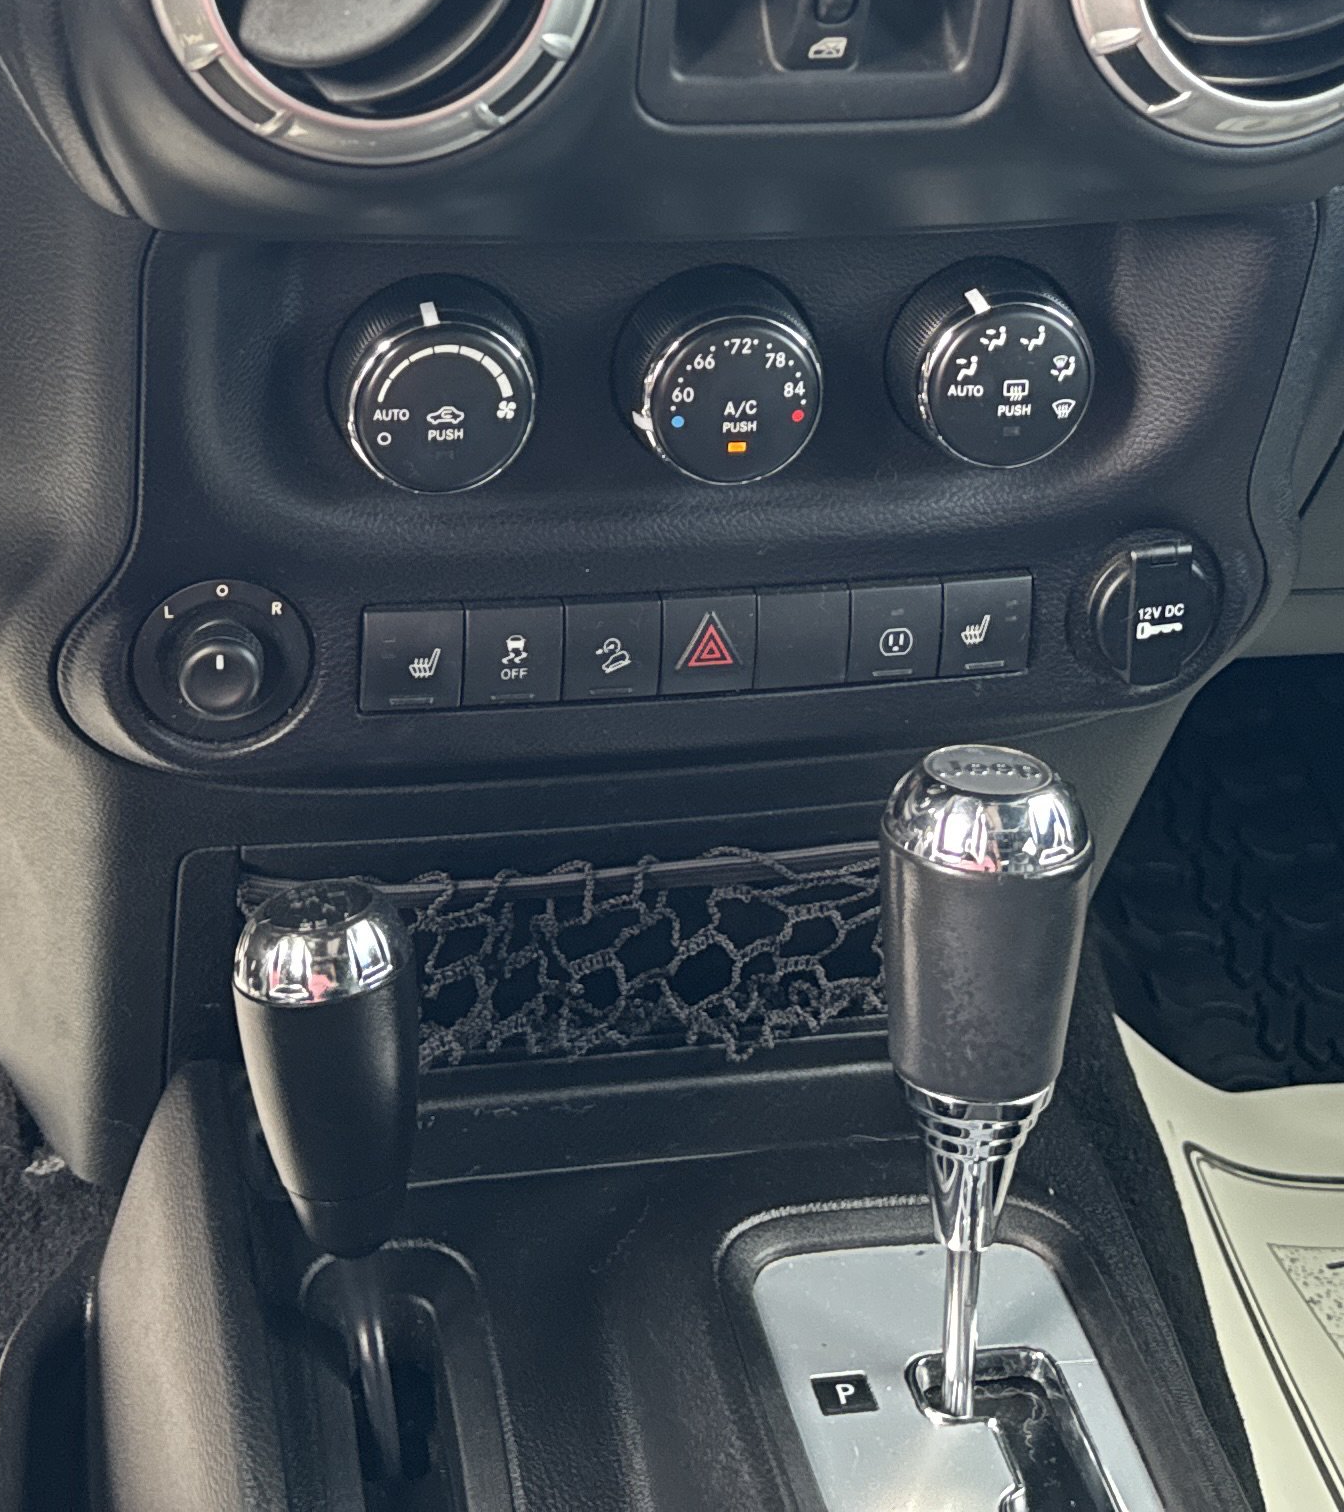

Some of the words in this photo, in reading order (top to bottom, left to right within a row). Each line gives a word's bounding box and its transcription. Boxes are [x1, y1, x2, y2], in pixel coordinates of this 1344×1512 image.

[731, 339, 752, 355] 72
[694, 353, 716, 370] 66
[765, 352, 786, 369] 78
[672, 385, 694, 403] 60
[783, 380, 806, 397] 84
[947, 384, 984, 398] AUTO
[373, 408, 410, 422] AUTO
[723, 399, 758, 419] A/C
[997, 403, 1032, 417] PUSH
[722, 418, 757, 433] PUSH
[427, 426, 464, 442] PUSH
[164, 605, 174, 619] L
[271, 601, 283, 616] R
[1138, 605, 1162, 621] 12V
[1165, 603, 1185, 618] DC
[500, 667, 528, 681] OFF
[834, 1383, 855, 1405] P
